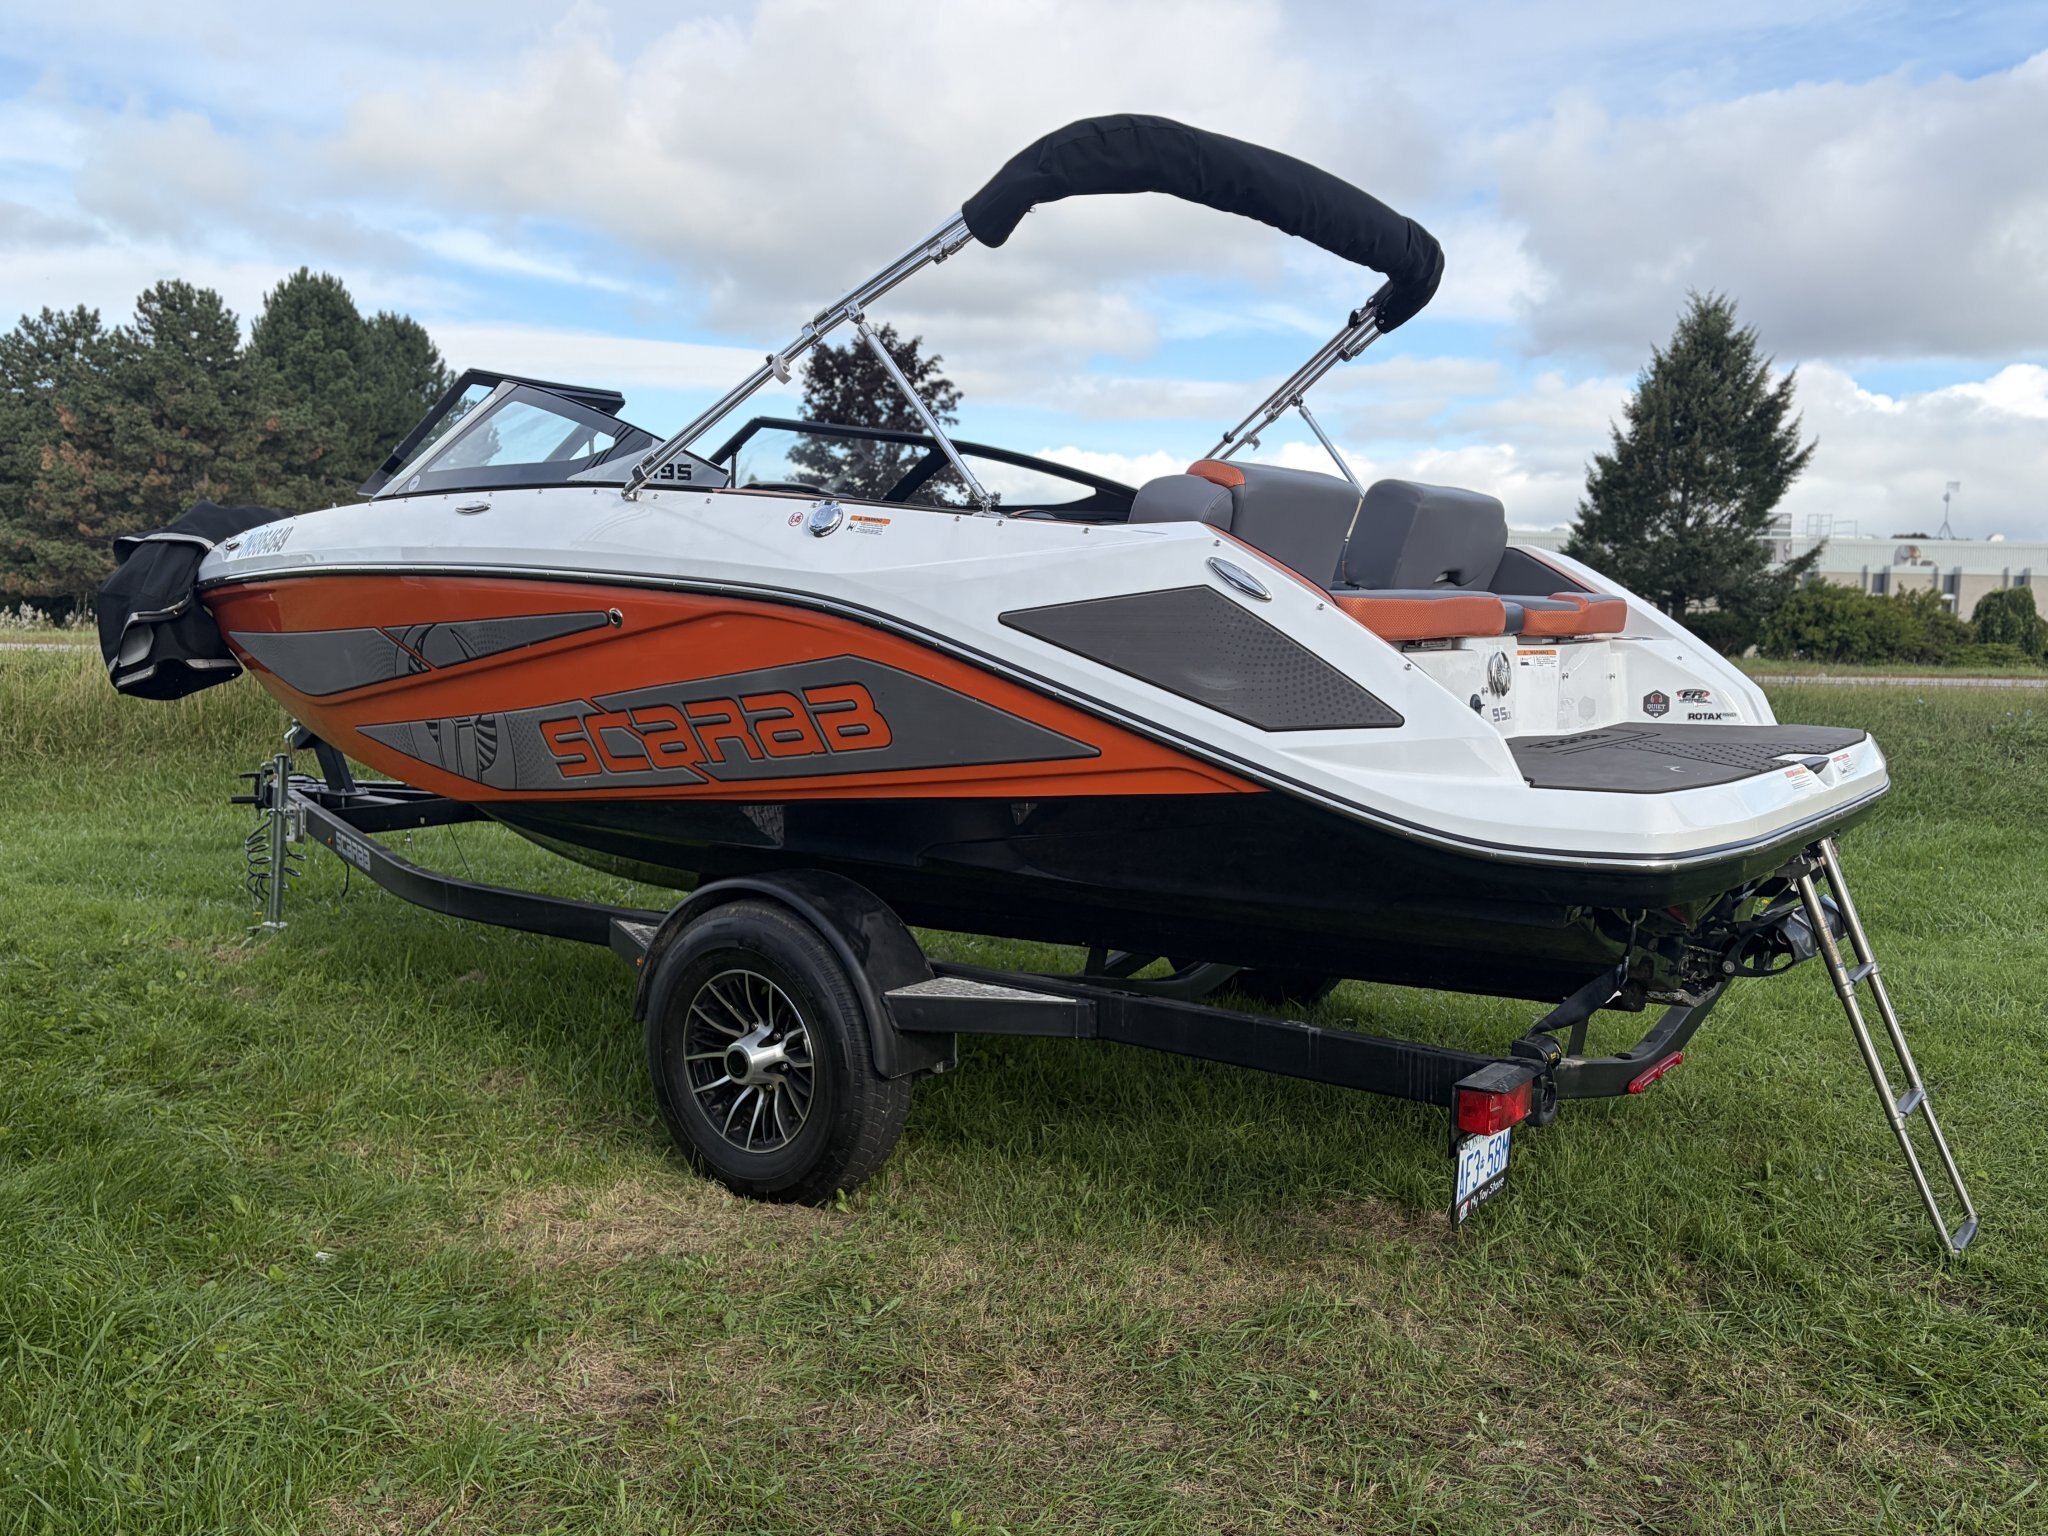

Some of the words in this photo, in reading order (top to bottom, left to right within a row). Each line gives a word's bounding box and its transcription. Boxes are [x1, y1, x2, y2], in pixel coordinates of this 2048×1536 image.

[653, 463, 692, 481] 95
[1646, 703, 1667, 711] QUIET
[1688, 712, 1722, 721] ROTAX
[539, 682, 893, 781] SCARAB
